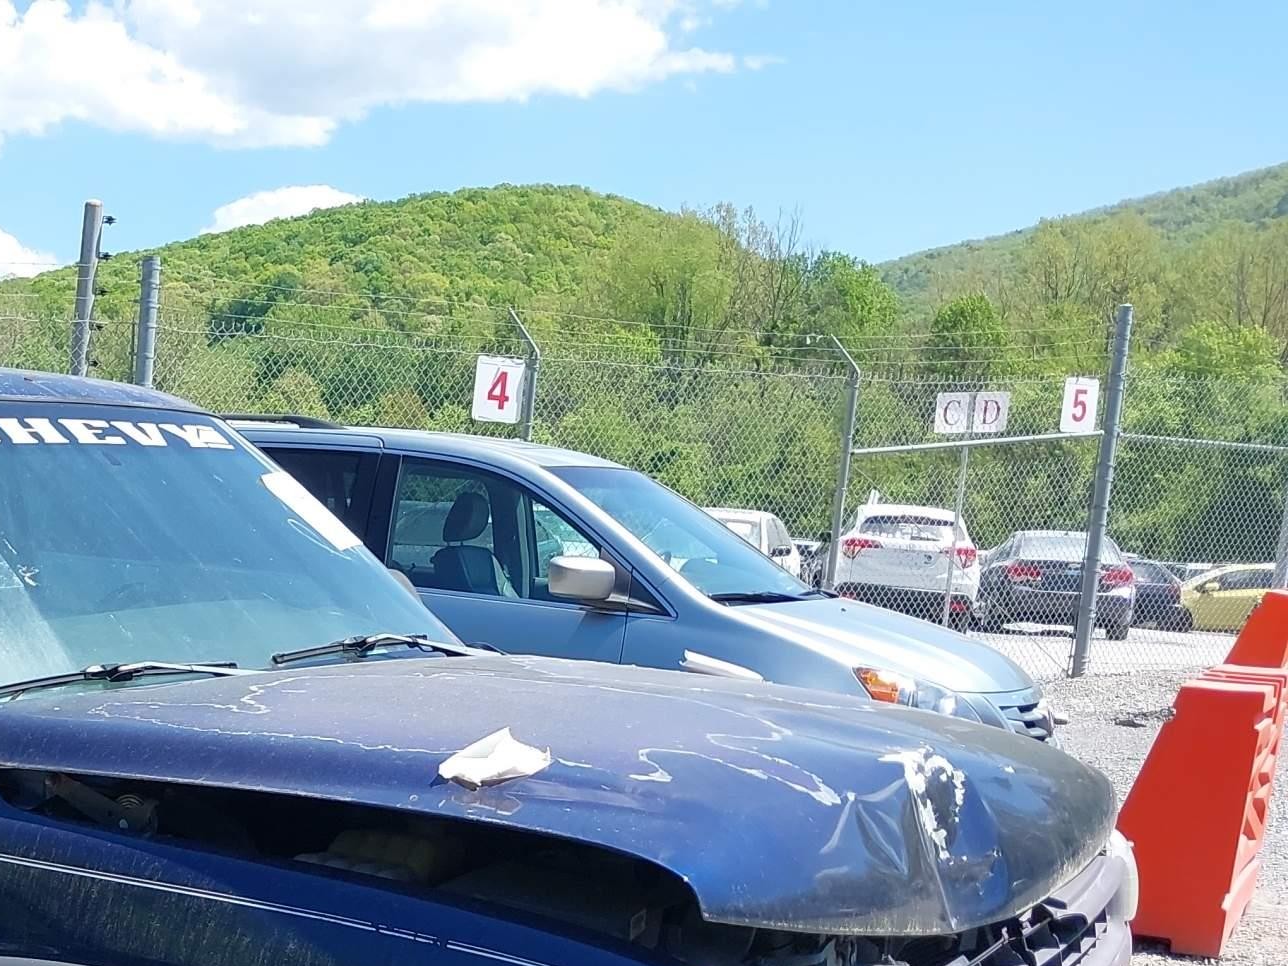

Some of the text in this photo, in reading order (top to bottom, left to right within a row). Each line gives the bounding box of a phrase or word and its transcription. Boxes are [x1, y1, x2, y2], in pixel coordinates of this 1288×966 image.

[487, 371, 510, 410] 4
[1071, 389, 1088, 422] 5
[943, 399, 961, 426] C
[982, 399, 1001, 425] D
